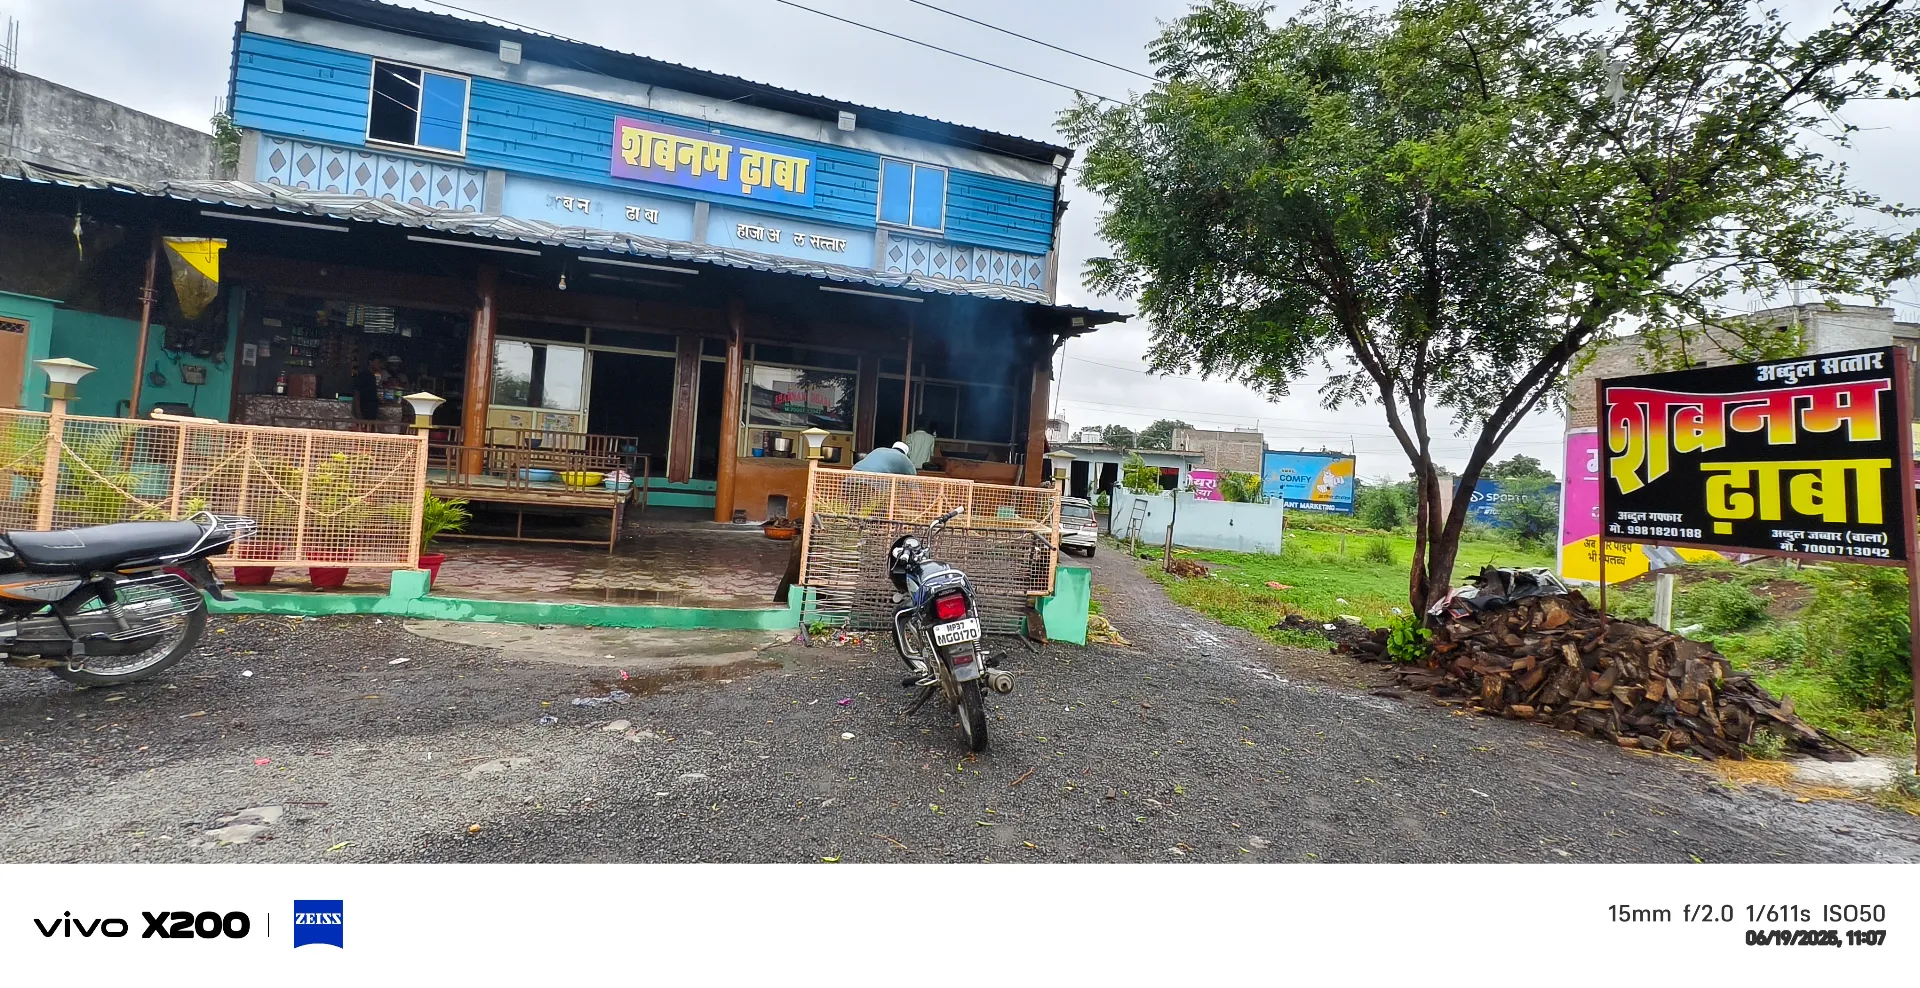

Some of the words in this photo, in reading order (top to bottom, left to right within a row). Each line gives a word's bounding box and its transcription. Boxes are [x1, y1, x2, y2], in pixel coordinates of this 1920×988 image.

[621, 125, 732, 180] शबनम
[1756, 359, 1817, 384] अब्दुल
[1821, 351, 1885, 375] सत्तार
[1606, 378, 1891, 495] शबनम
[1279, 474, 1312, 484] COMFY
[1299, 502, 1335, 511] MARKETING
[1617, 511, 1648, 524] अब्दुल
[1608, 522, 1625, 534] मो.
[1627, 525, 1702, 538] 9981820188
[1771, 529, 1805, 542] अब्दुल
[1779, 540, 1798, 552] मो.
[1801, 543, 1890, 558] 7000713042
[1599, 554, 1627, 566] पलब्ध
[947, 622, 965, 631] MP37
